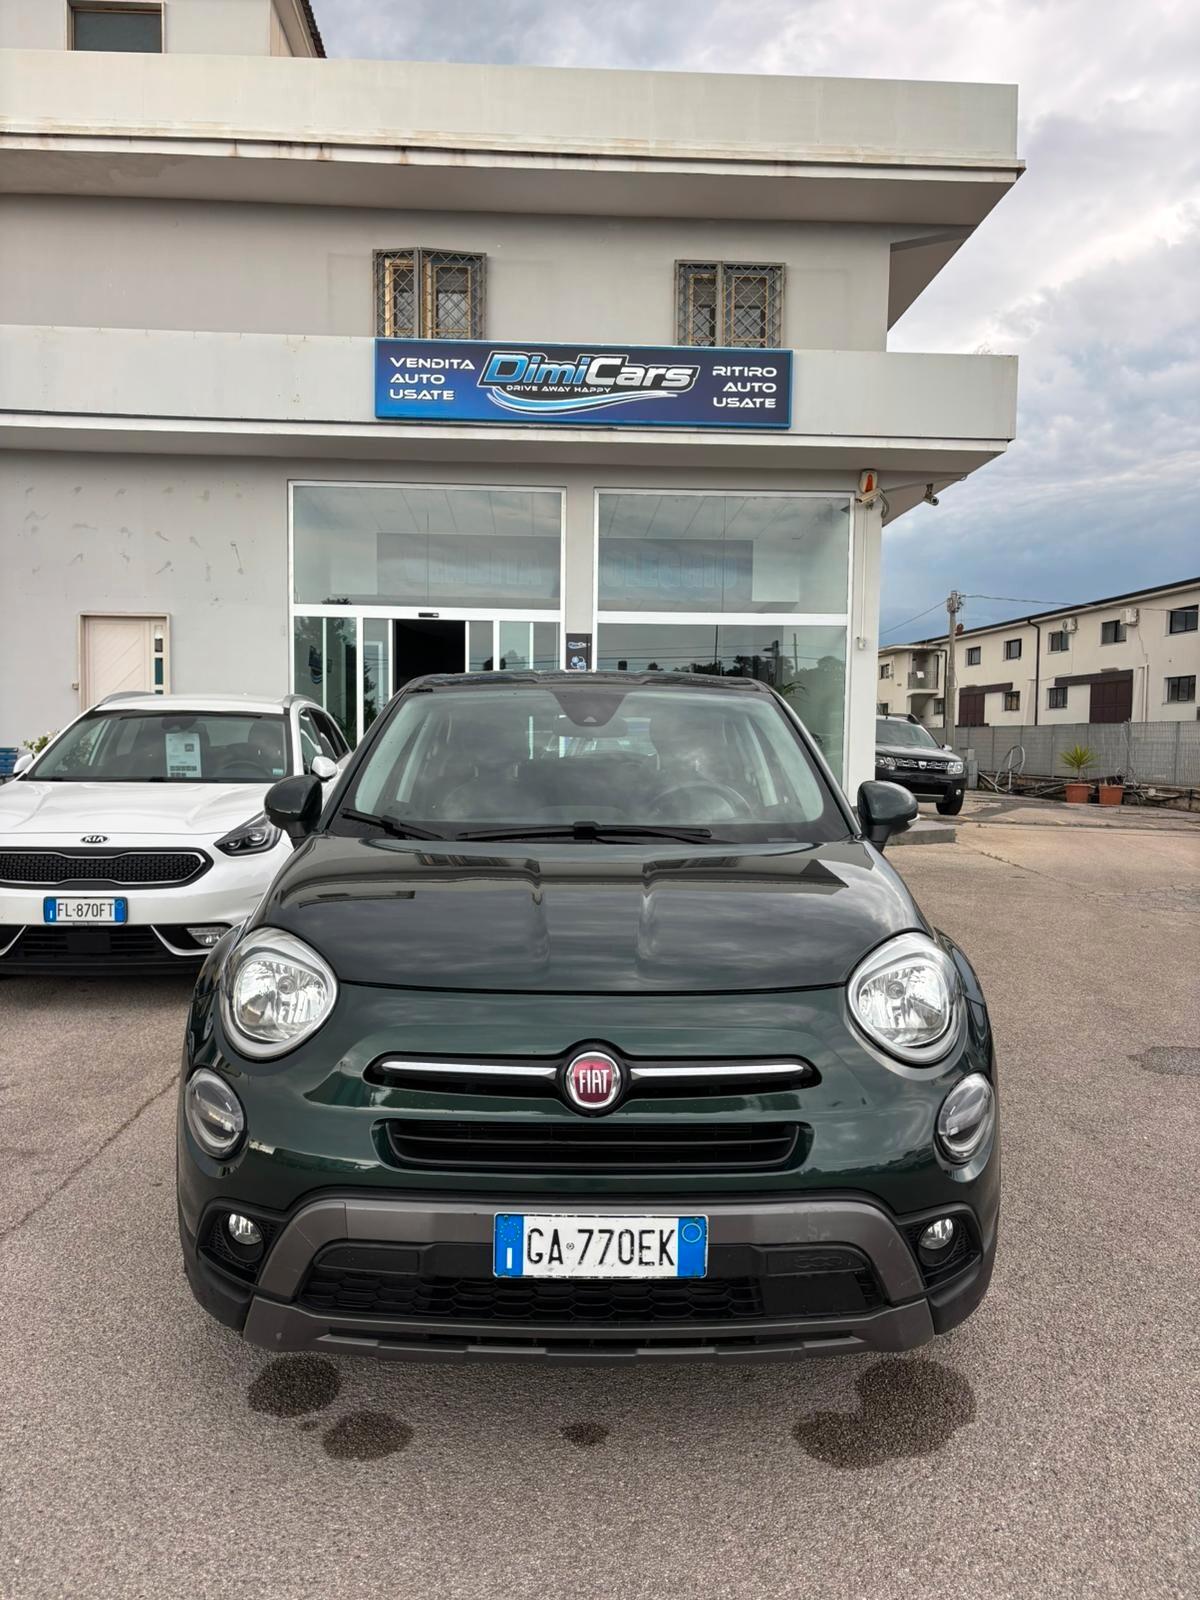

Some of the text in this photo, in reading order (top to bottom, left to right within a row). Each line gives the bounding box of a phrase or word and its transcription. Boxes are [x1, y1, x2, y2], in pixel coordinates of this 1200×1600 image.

[389, 356, 476, 371] VENDITA
[483, 353, 694, 388] DimiCars
[712, 365, 778, 378] RITIRO
[389, 373, 446, 385] AUTO
[506, 384, 612, 394] DRIVE AWAY HAPPY
[722, 381, 777, 394] AUTO
[389, 388, 456, 401] USATE
[712, 396, 777, 409] USATE
[84, 834, 104, 843] KIA
[579, 1069, 610, 1094] FIAT
